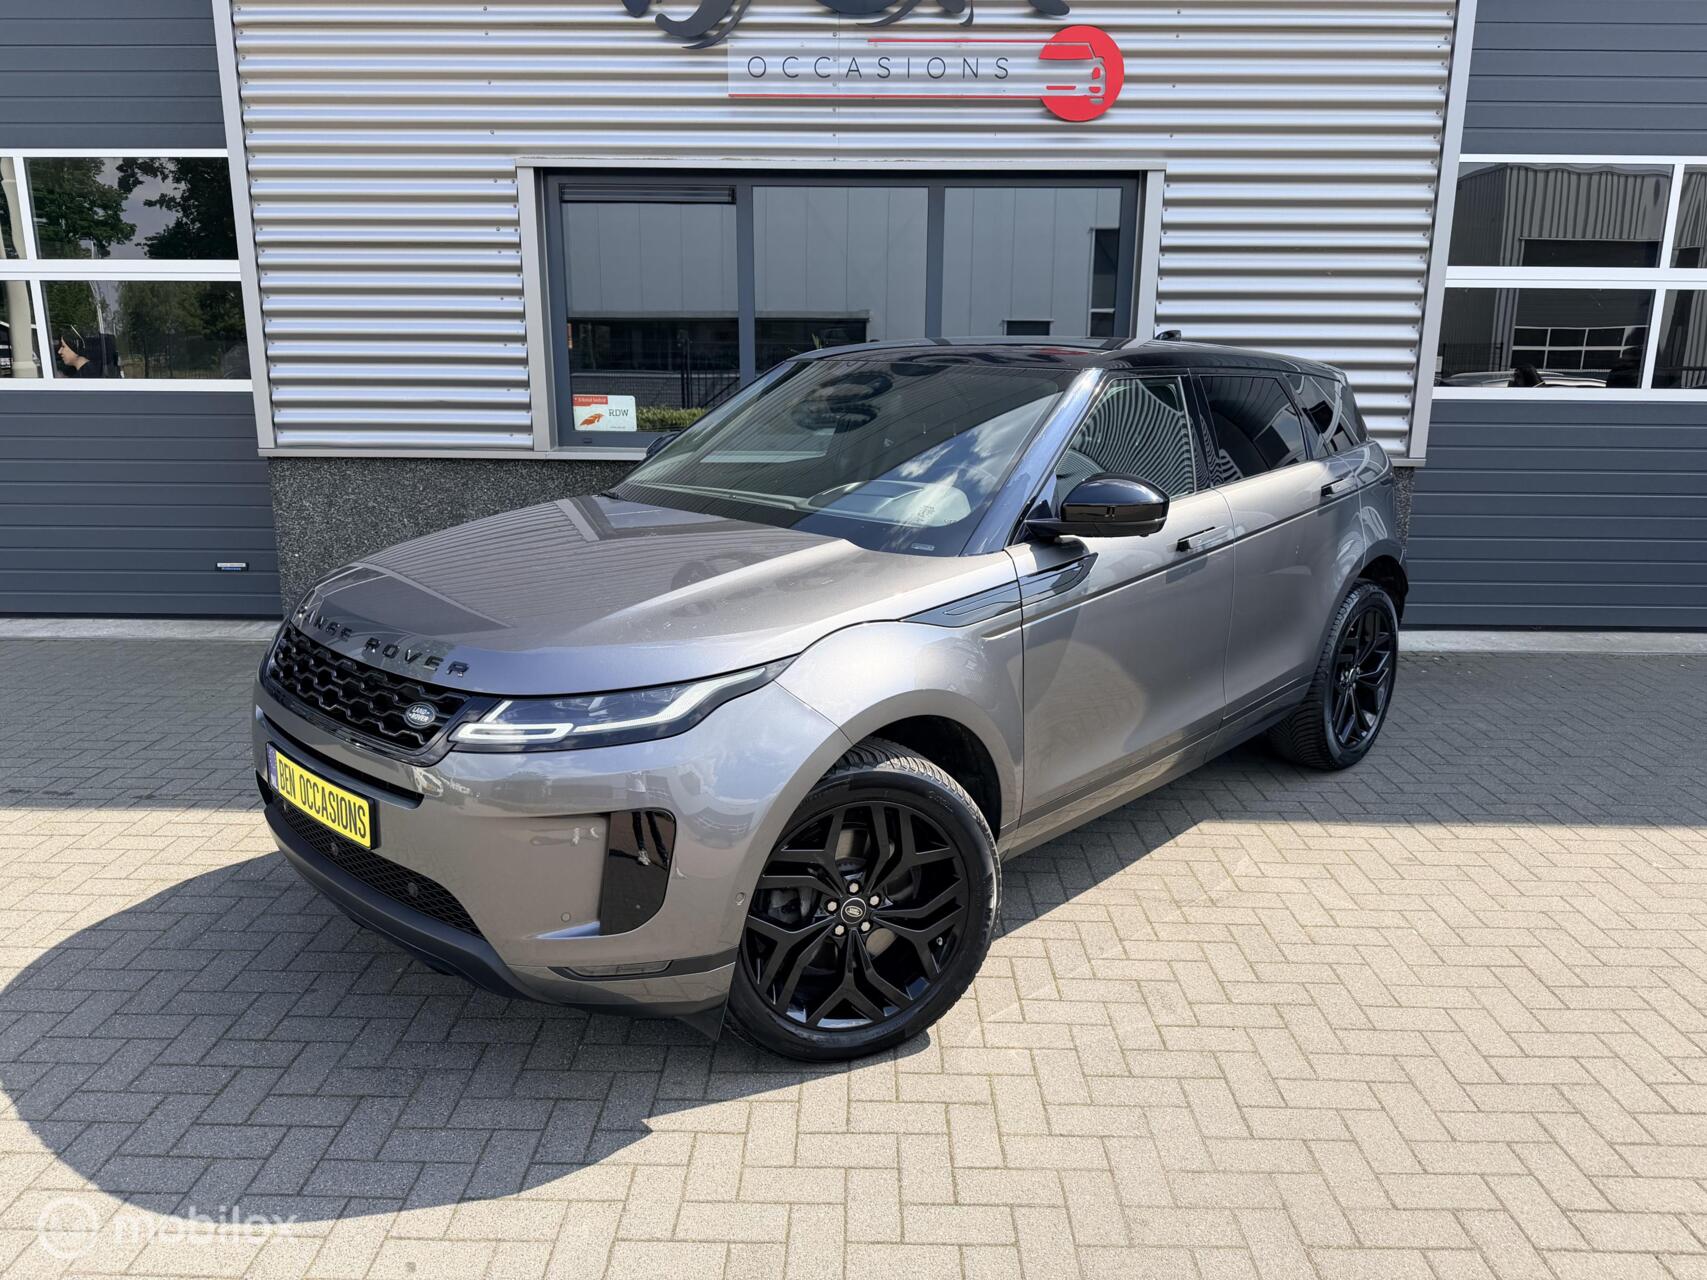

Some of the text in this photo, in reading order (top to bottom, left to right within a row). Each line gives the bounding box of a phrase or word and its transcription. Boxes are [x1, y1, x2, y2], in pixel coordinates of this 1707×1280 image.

[747, 56, 1009, 80] OCCASIONS
[608, 408, 629, 417] RDW
[364, 637, 470, 677] ROVER
[278, 758, 367, 839] BEN OCCASIONS
